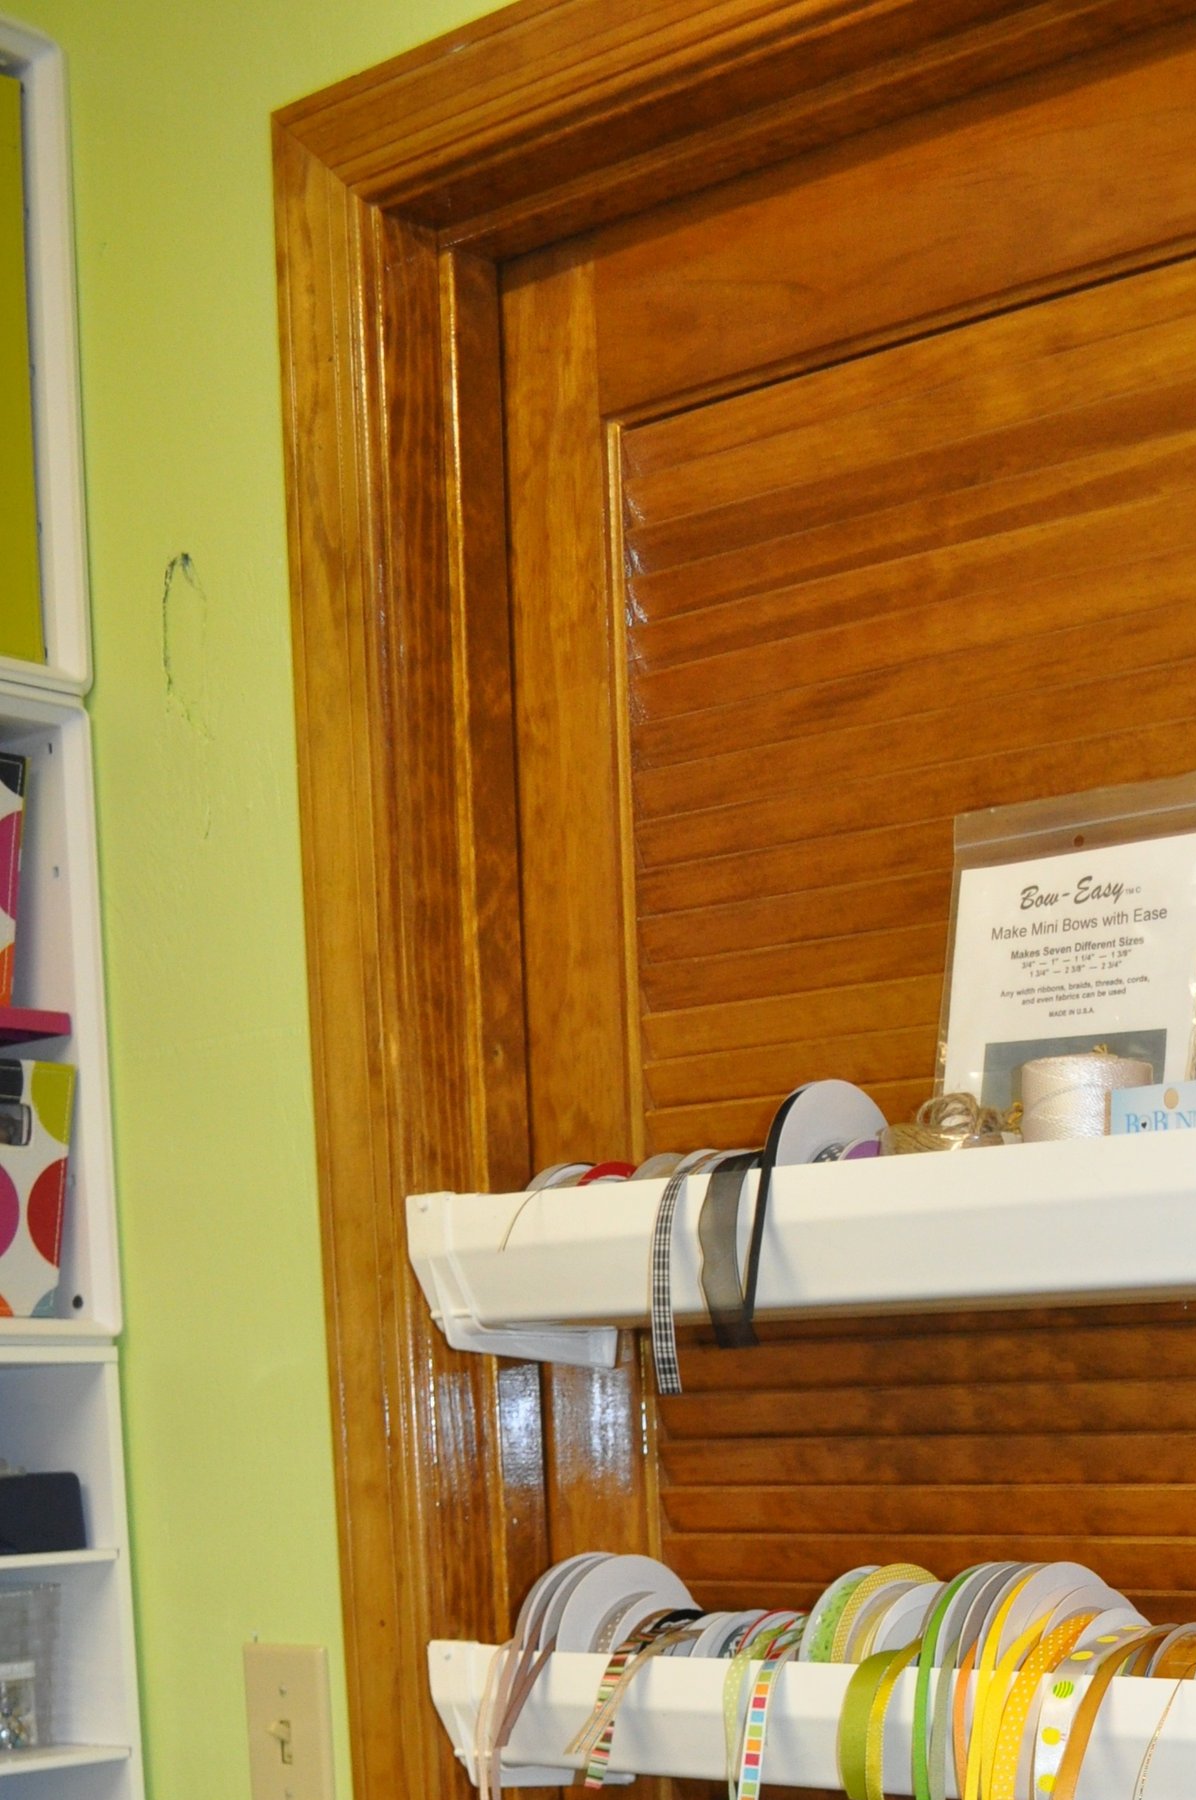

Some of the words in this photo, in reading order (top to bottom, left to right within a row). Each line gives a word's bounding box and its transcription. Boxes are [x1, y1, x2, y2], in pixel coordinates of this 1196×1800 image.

[1020, 875, 1124, 911] Bow-Easy
[991, 926, 1027, 941] Make
[1031, 919, 1058, 936] Mini
[1062, 915, 1098, 932] Bows
[1102, 911, 1129, 927] with
[1133, 907, 1168, 923] Ease
[1010, 948, 1040, 961] Makes
[1043, 945, 1072, 957] Seven
[1074, 939, 1117, 953] Different
[1119, 936, 1145, 947] Sizes
[1000, 990, 1015, 998] Any
[1016, 987, 1036, 997] width
[1021, 997, 1036, 1006] and
[1036, 996, 1054, 1004] even
[1055, 992, 1080, 1002] fabrics
[1081, 991, 1096, 999] can
[1097, 988, 1107, 997] be
[1108, 987, 1127, 997] used
[1048, 1010, 1068, 1018] MADE
